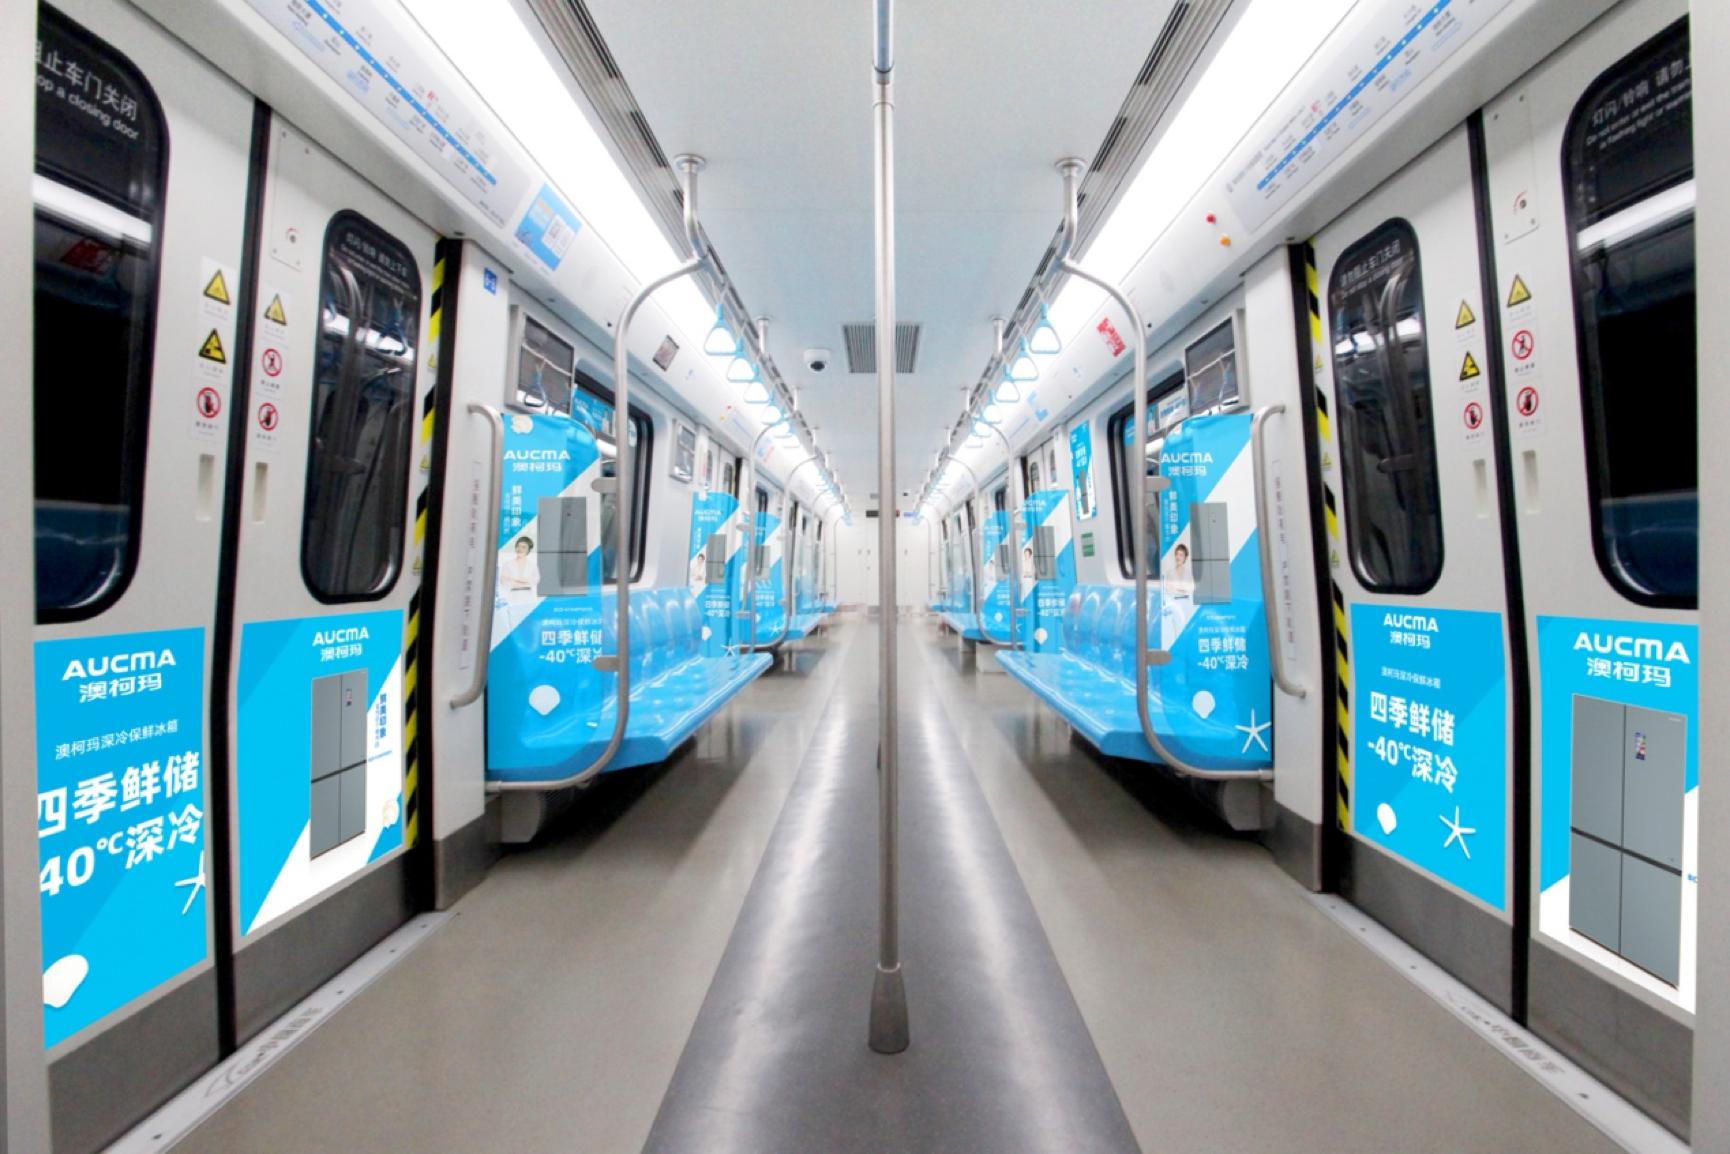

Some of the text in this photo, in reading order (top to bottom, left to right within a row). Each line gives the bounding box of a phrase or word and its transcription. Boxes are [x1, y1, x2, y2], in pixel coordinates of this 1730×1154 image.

[68, 94, 111, 127] closing
[112, 120, 139, 139] door
[503, 450, 570, 460] AUCMA
[513, 461, 562, 472] 澳柯玛
[1161, 452, 1213, 464] AUCMA
[1168, 466, 1207, 476] 澳柯玛
[1383, 613, 1439, 632] AUCMA
[313, 627, 369, 646] AUCMA
[1390, 631, 1430, 649] 澳柯玛
[1573, 632, 1691, 664] AUCMA
[321, 643, 362, 662] 澳柯玛
[62, 650, 176, 680] AUCMA
[1587, 657, 1671, 688] 澳柯玛
[79, 673, 161, 703] 澳柯玛
[1370, 691, 1455, 746] 四季鲜储
[55, 719, 178, 760] 澳柯玛深冷保鲜冰箱
[38, 751, 199, 839] 四季鲜储
